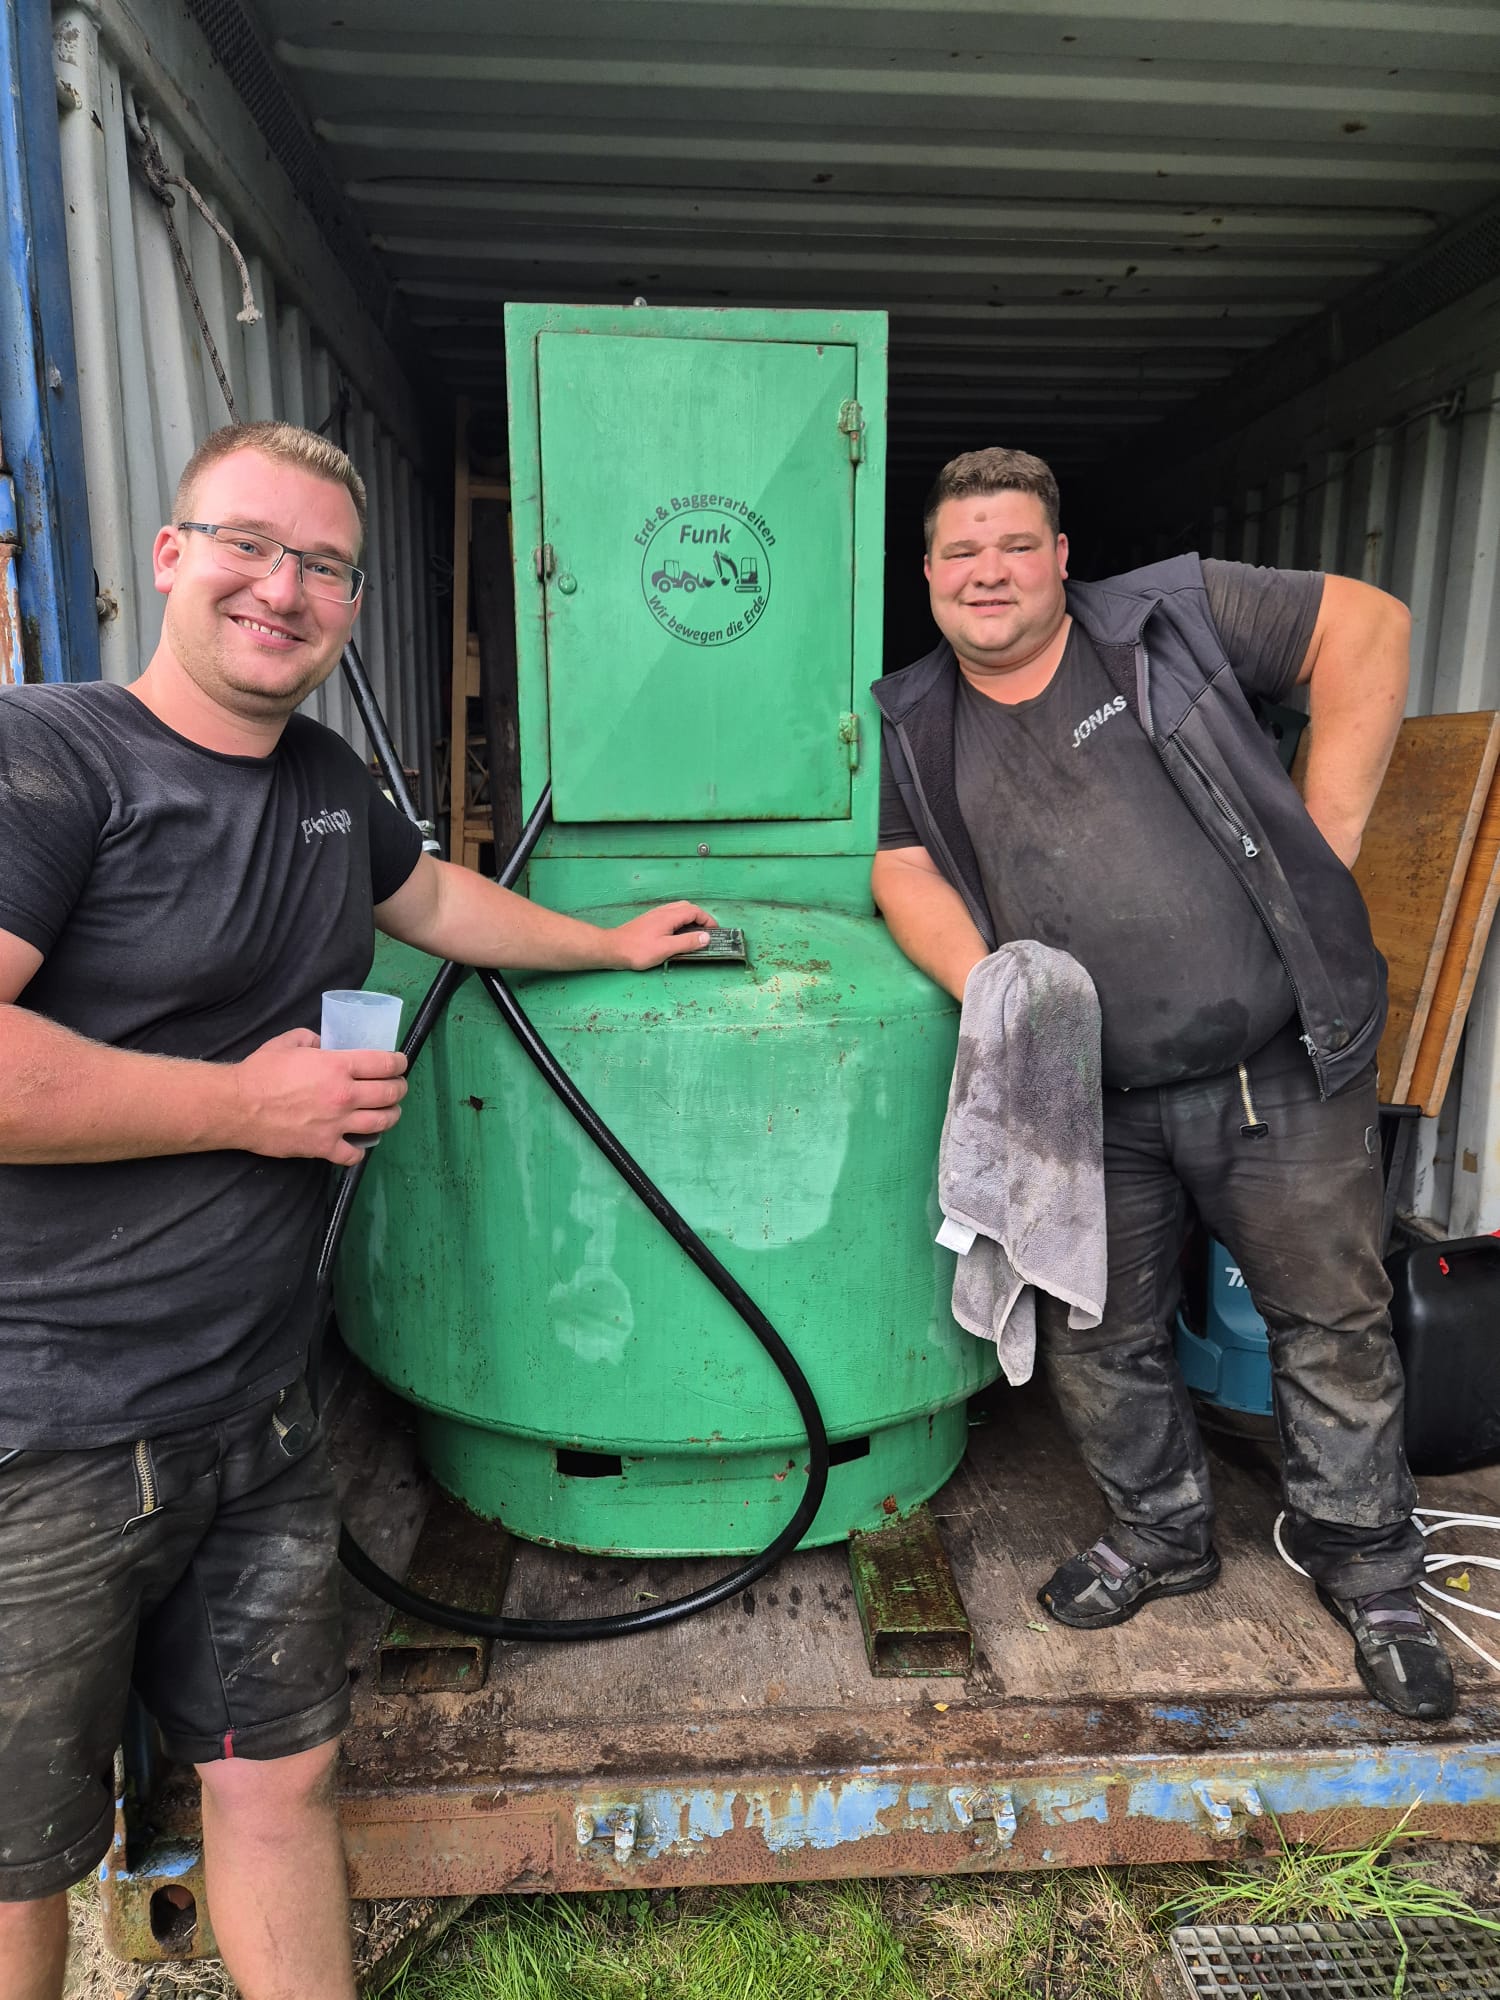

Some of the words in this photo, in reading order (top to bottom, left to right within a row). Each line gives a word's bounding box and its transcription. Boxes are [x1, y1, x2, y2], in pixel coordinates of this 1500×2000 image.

[670, 494, 776, 547] Baggerarbeiten
[679, 523, 732, 544] Funk
[649, 594, 669, 620] Wir
[667, 616, 723, 644] bewegen
[726, 619, 744, 638] die
[743, 595, 765, 624] Erde
[1071, 695, 1128, 749] JONAS
